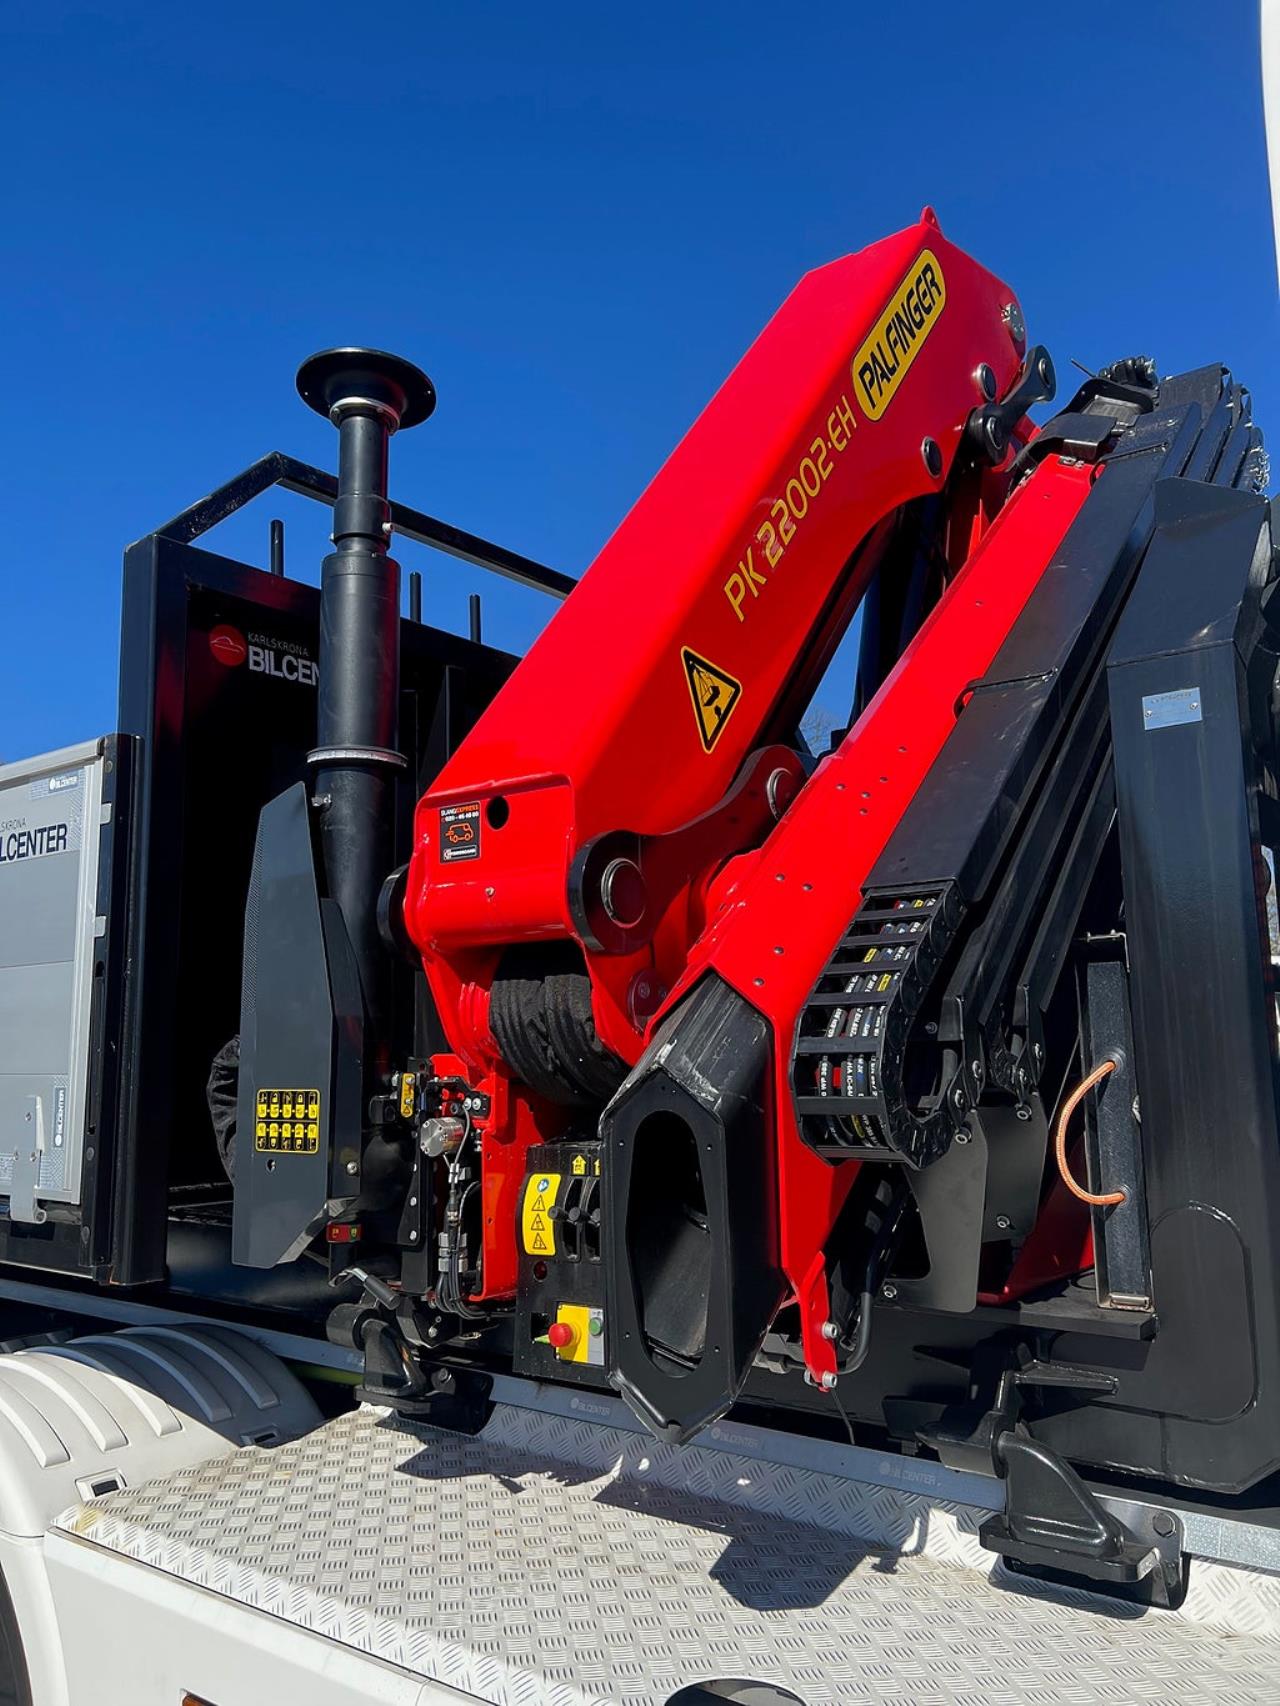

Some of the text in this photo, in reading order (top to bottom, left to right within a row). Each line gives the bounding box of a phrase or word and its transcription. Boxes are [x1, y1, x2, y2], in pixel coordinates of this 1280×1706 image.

[858, 262, 942, 410] PALFINGER
[723, 547, 767, 623] PK
[247, 632, 309, 657] KARLSKRONA
